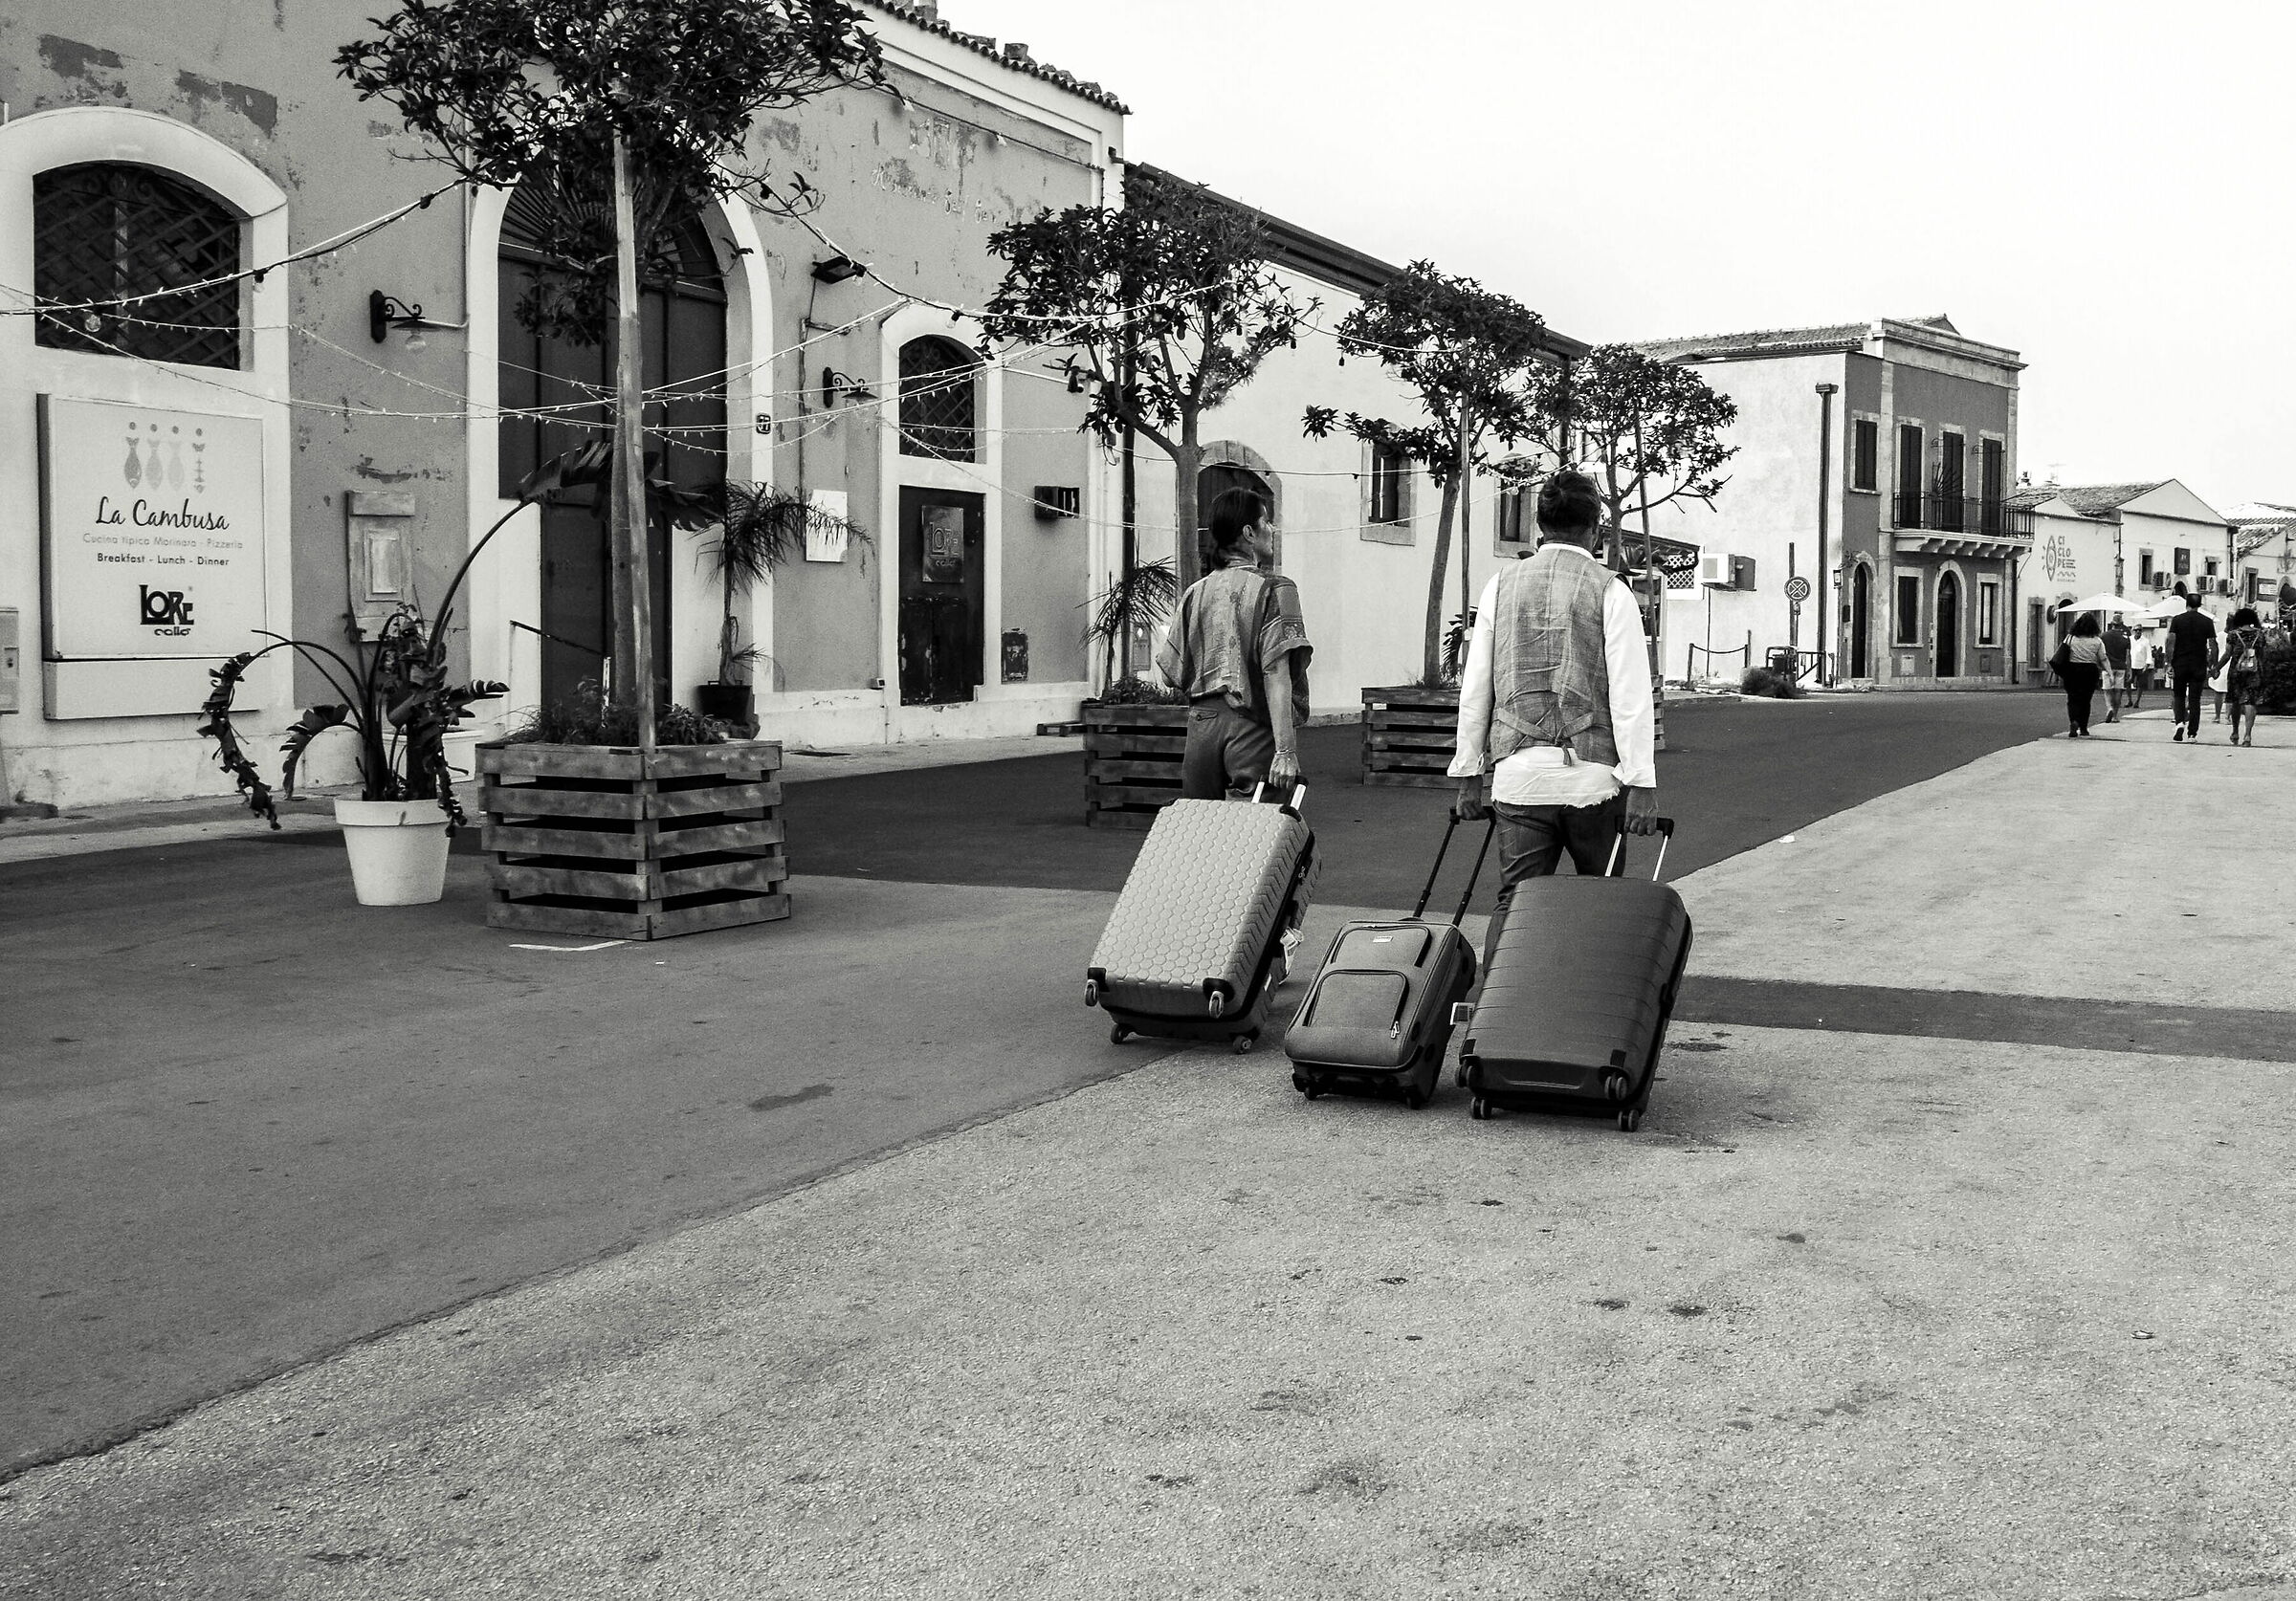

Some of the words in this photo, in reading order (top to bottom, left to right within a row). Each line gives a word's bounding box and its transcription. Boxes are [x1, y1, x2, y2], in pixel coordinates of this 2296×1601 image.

[96, 496, 125, 524] La
[132, 498, 230, 531] Cambusa
[82, 533, 119, 544] Cucina
[153, 536, 197, 548] Marinara
[207, 537, 243, 549] Pizzeria
[97, 552, 145, 563] Breakfast
[157, 555, 186, 565] Lunch
[197, 556, 230, 566] Dinner
